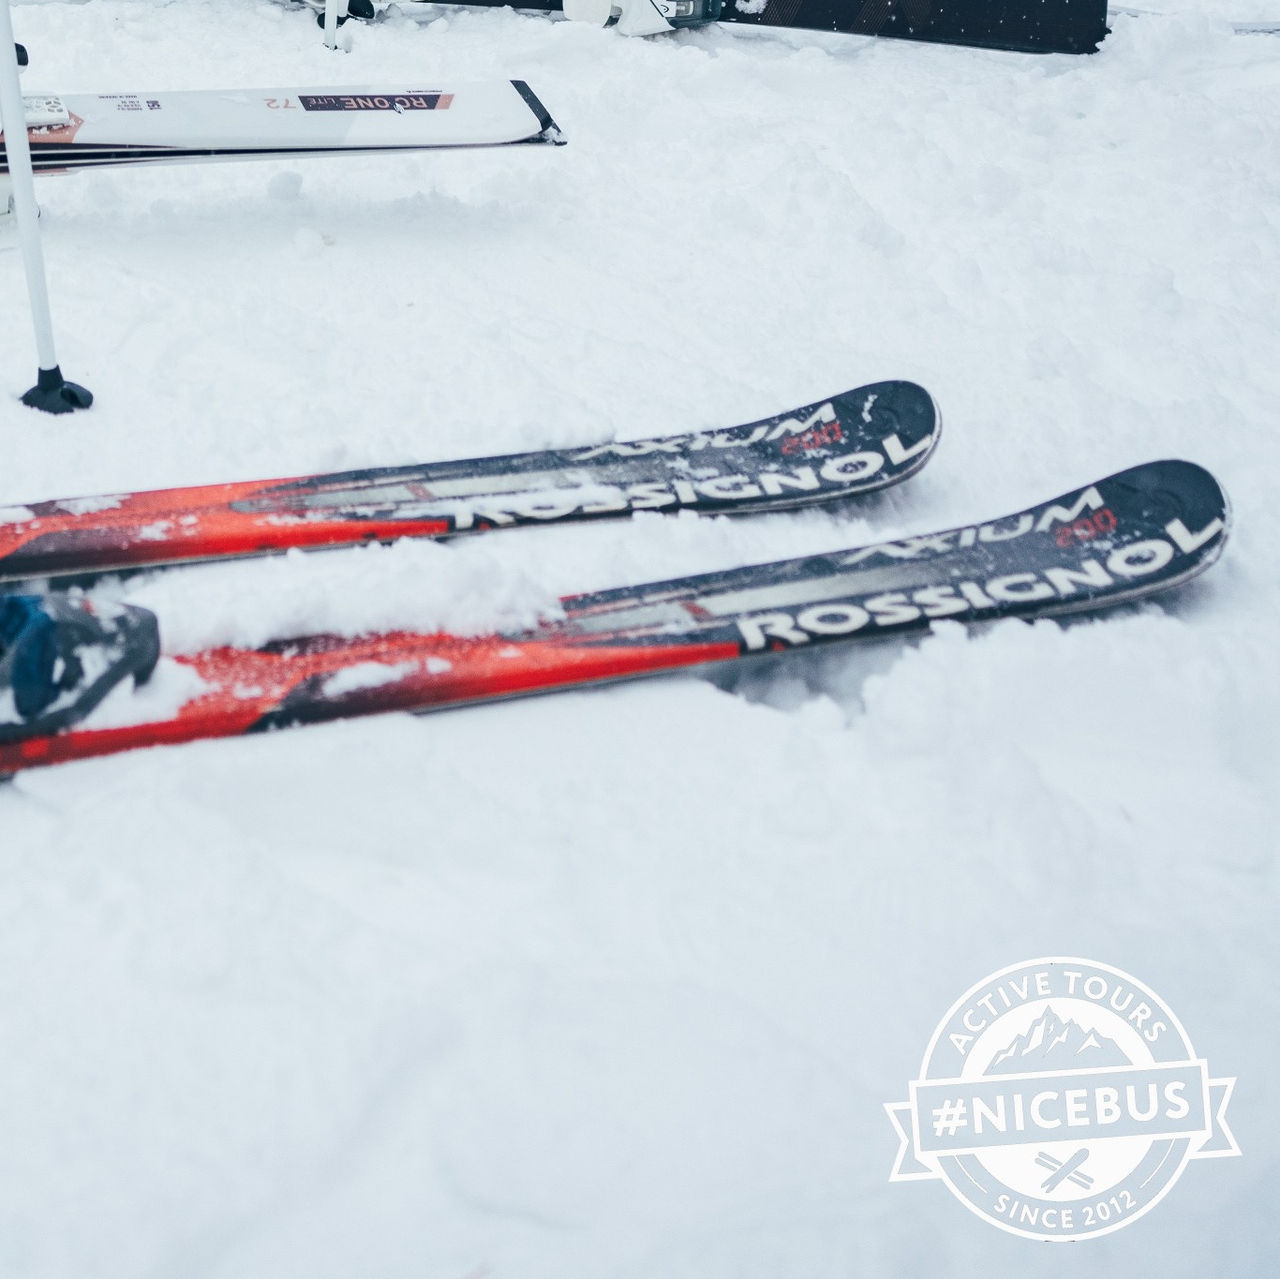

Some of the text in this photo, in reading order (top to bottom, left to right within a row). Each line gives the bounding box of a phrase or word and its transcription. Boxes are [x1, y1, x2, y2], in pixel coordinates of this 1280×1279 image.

[264, 96, 429, 110] RC ONE LITE 72
[736, 517, 1225, 652] ROSSIGNOL
